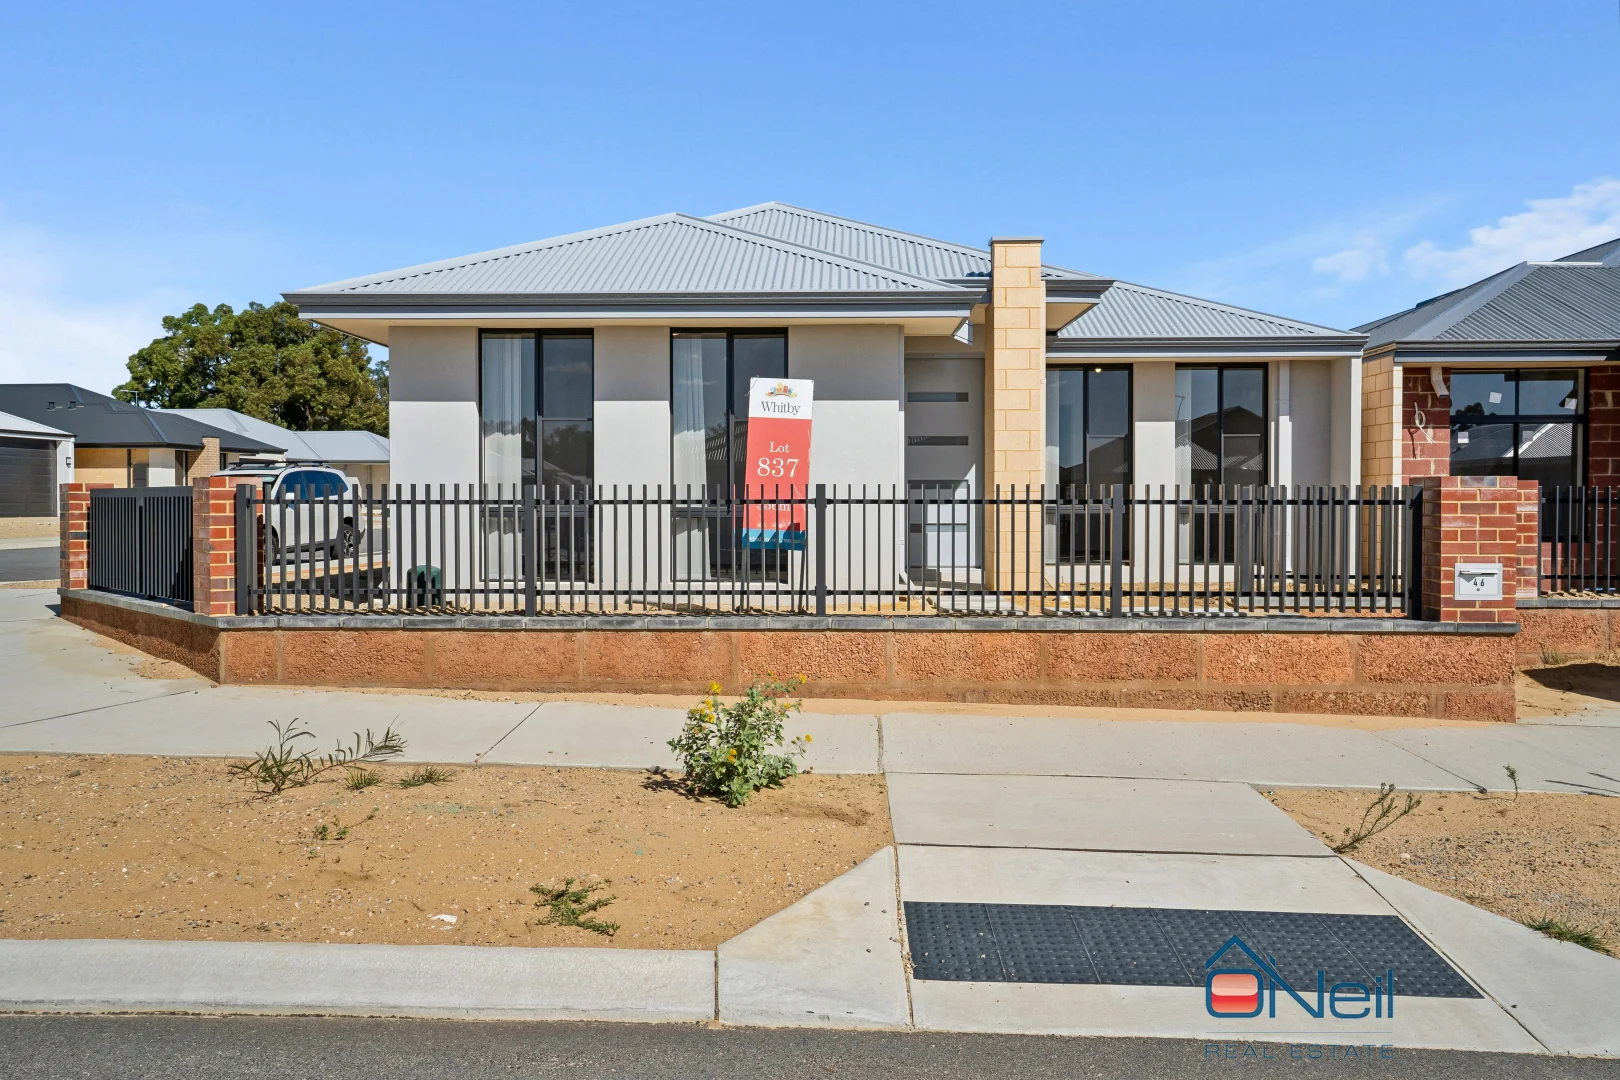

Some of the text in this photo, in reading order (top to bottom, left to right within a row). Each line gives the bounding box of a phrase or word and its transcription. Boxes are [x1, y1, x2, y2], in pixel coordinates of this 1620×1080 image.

[761, 401, 801, 415] Whitby
[769, 441, 790, 453] Lot
[757, 457, 799, 478] 837
